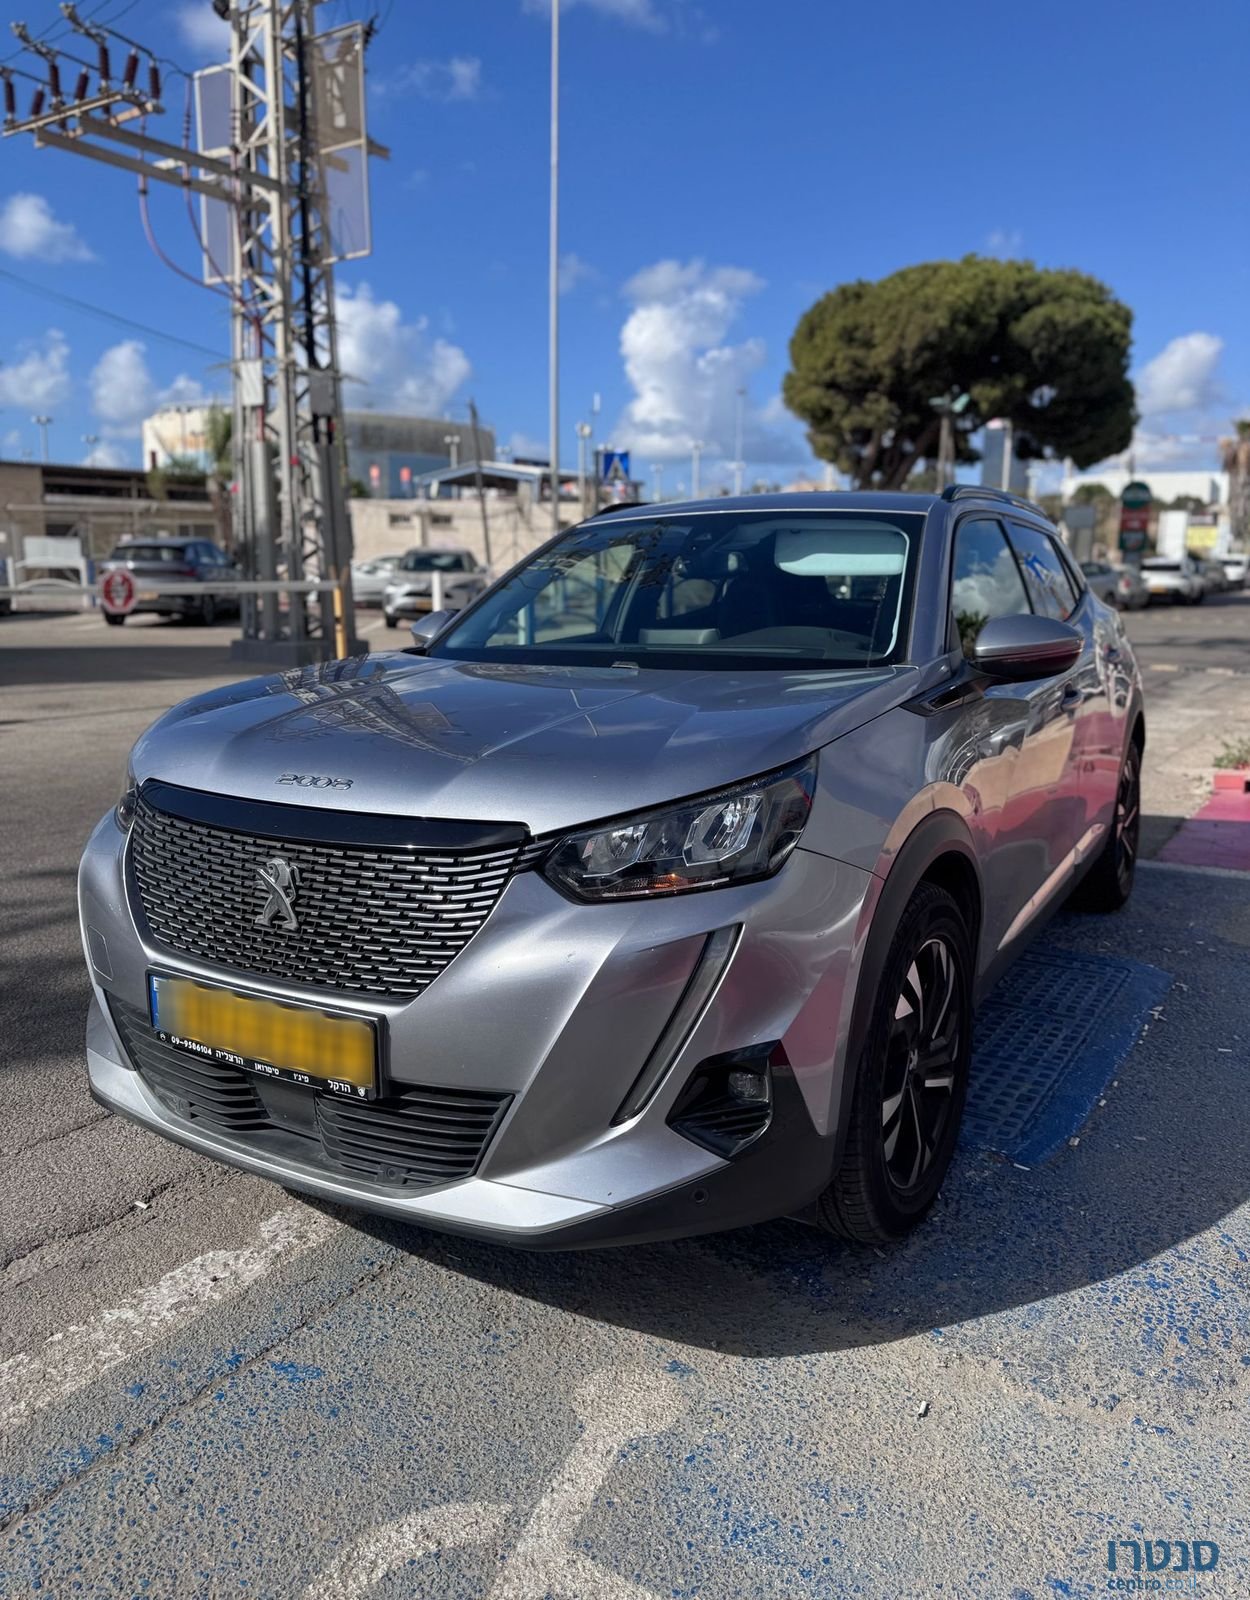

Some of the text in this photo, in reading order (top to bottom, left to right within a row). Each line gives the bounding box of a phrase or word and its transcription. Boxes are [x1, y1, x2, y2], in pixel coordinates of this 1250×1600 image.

[274, 774, 354, 790] 2008
[215, 1050, 244, 1065] הרצליה
[327, 1079, 351, 1093] הדקל
